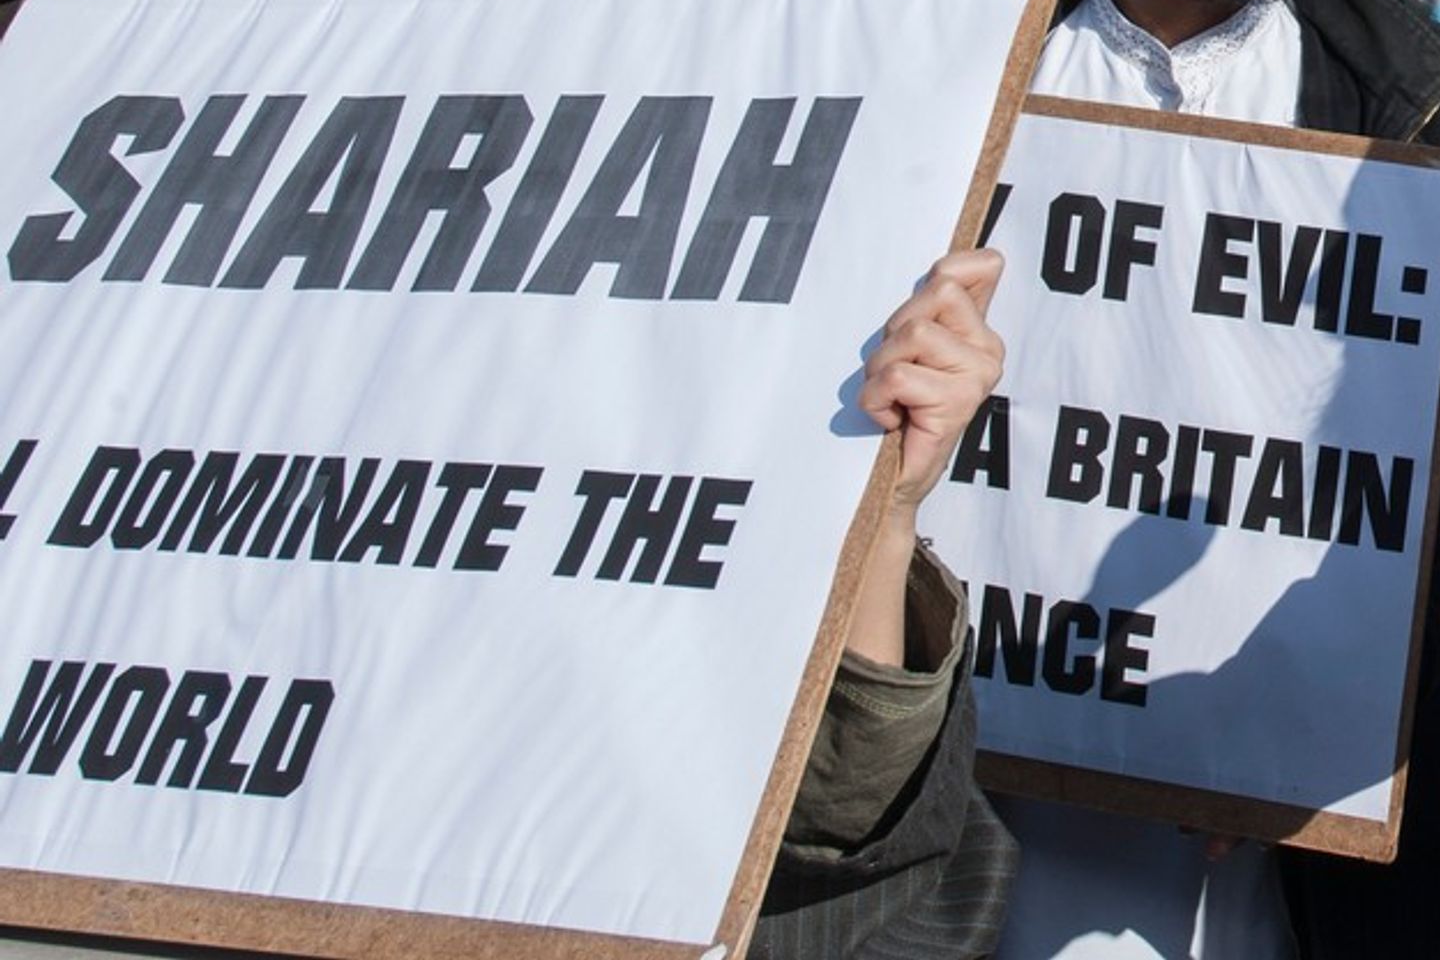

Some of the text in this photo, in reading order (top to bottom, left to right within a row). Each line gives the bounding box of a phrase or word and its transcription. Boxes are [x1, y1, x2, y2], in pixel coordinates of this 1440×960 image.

[8, 94, 863, 304] SHARIAH
[1041, 192, 1164, 302] OF
[1192, 212, 1428, 346] EVIL:
[46, 445, 545, 572] DOMINATE
[553, 469, 754, 590] THE
[1046, 405, 1415, 554] BRITAIN
[961, 581, 1156, 708] NCE
[0, 659, 336, 798] WORLD
